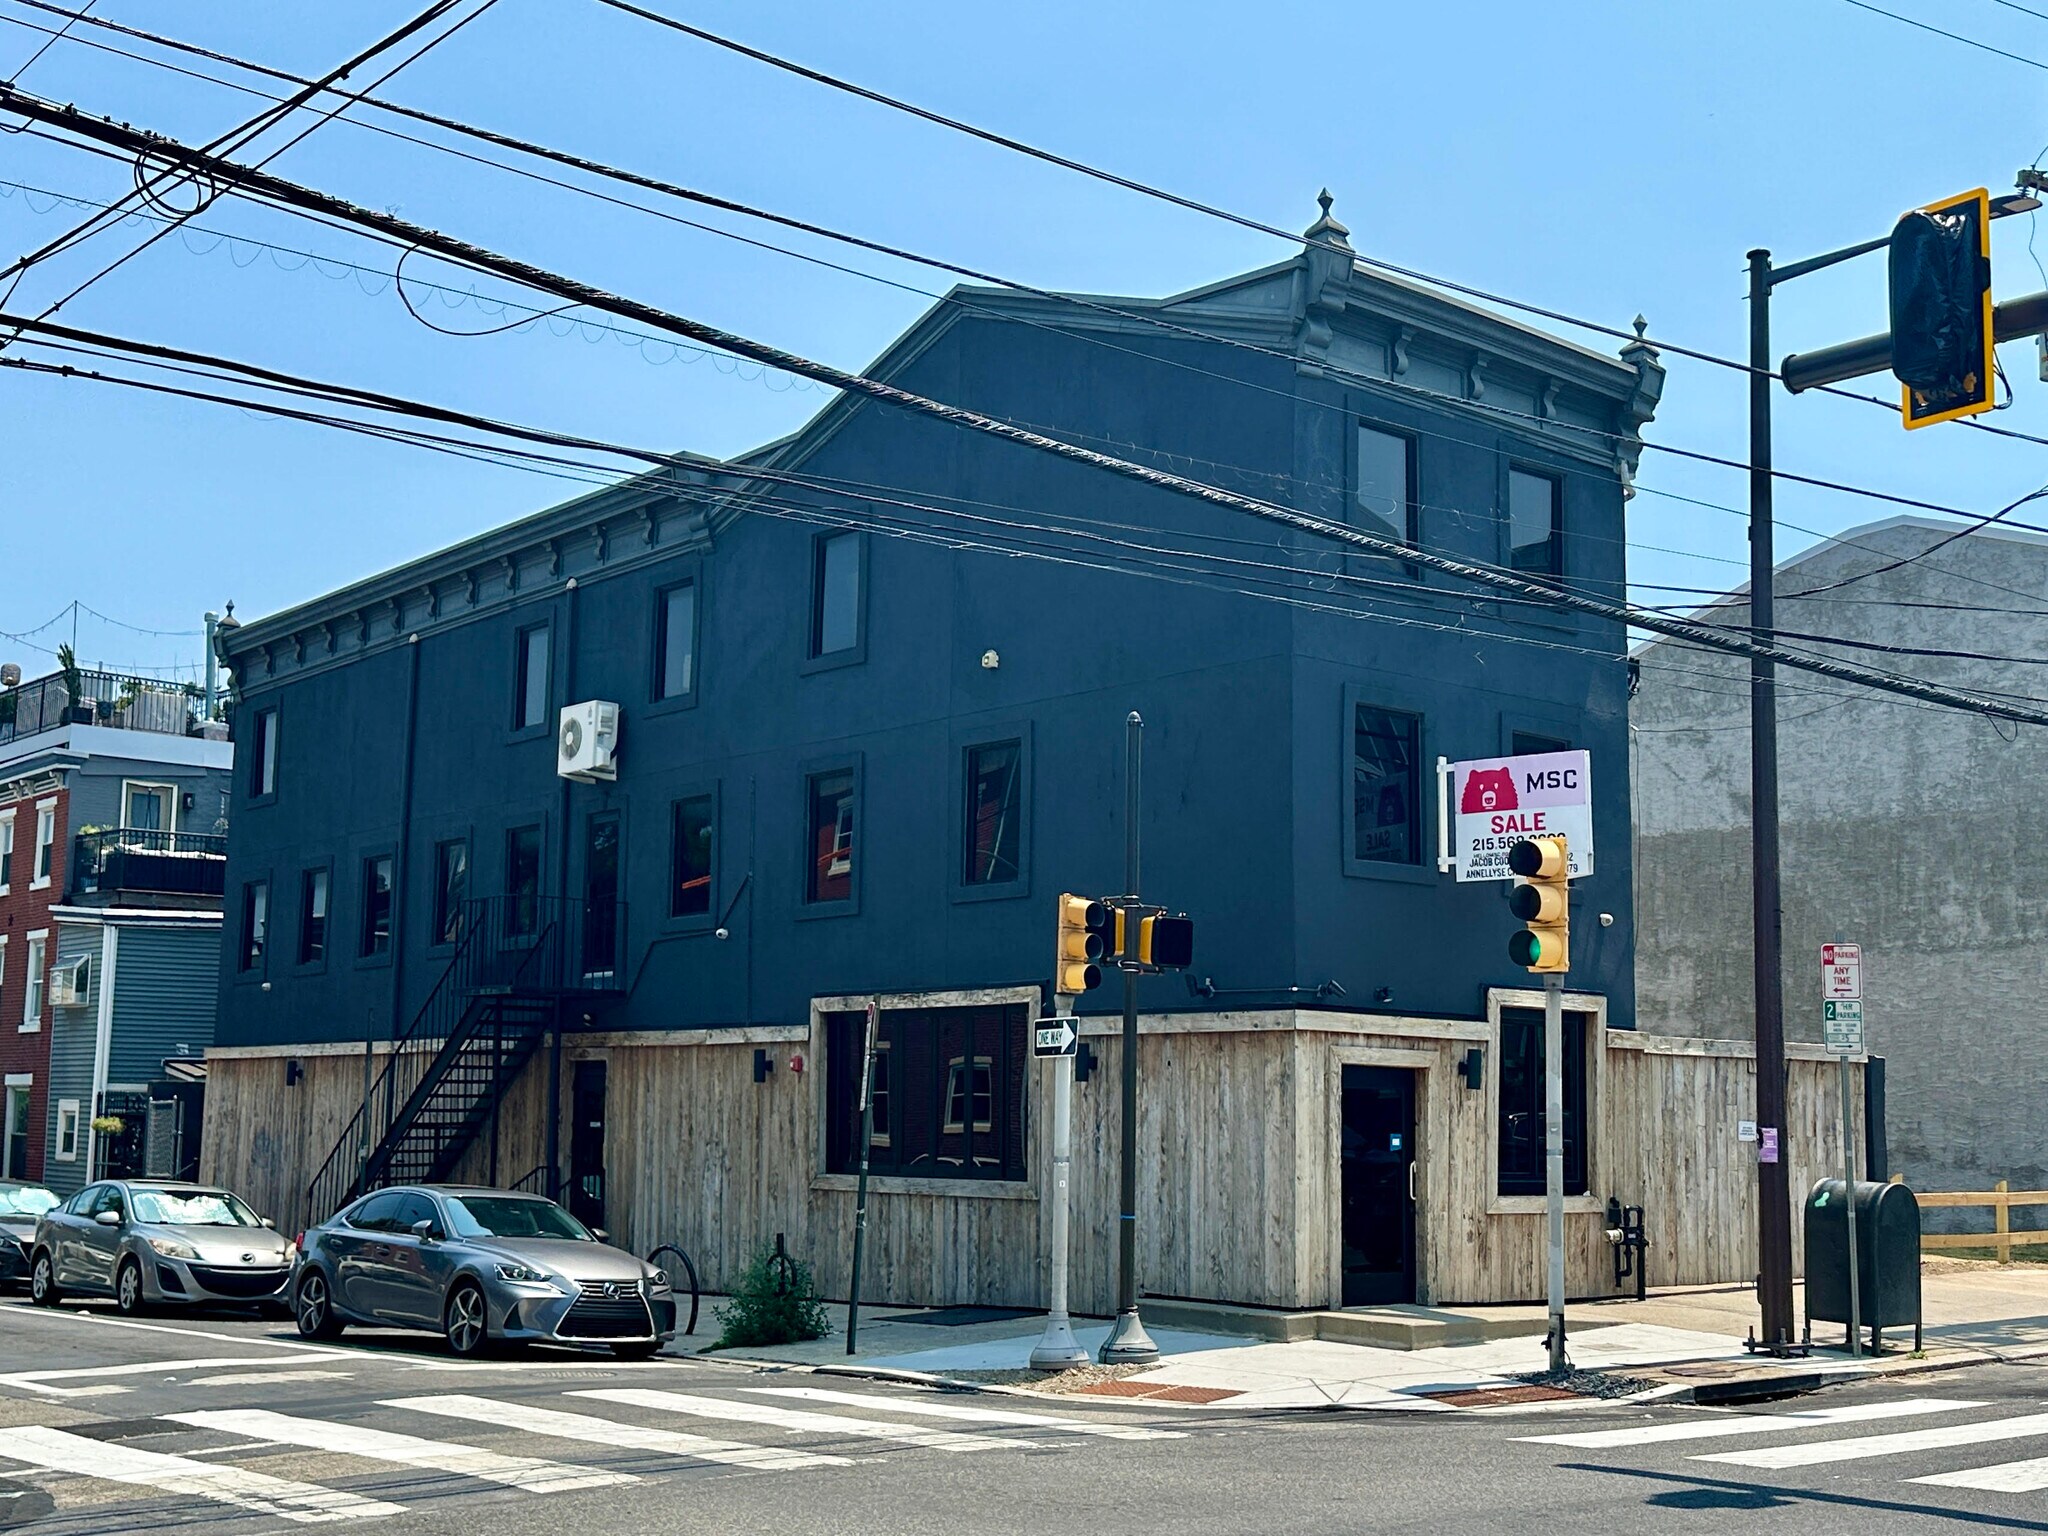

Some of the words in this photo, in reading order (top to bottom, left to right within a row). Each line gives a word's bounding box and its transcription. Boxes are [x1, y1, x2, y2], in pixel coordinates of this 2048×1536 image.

[1526, 769, 1577, 793] MSC
[1491, 812, 1546, 834] SALE
[1469, 857, 1493, 867] JACOB
[1466, 868, 1506, 879] ANNELLYSE
[1823, 950, 1834, 960] NO
[1834, 966, 1850, 975] ANY
[1833, 976, 1852, 985] TIME
[1826, 1003, 1834, 1018] 2
[1038, 1031, 1049, 1045] ONE
[1051, 1030, 1063, 1044] WAY
